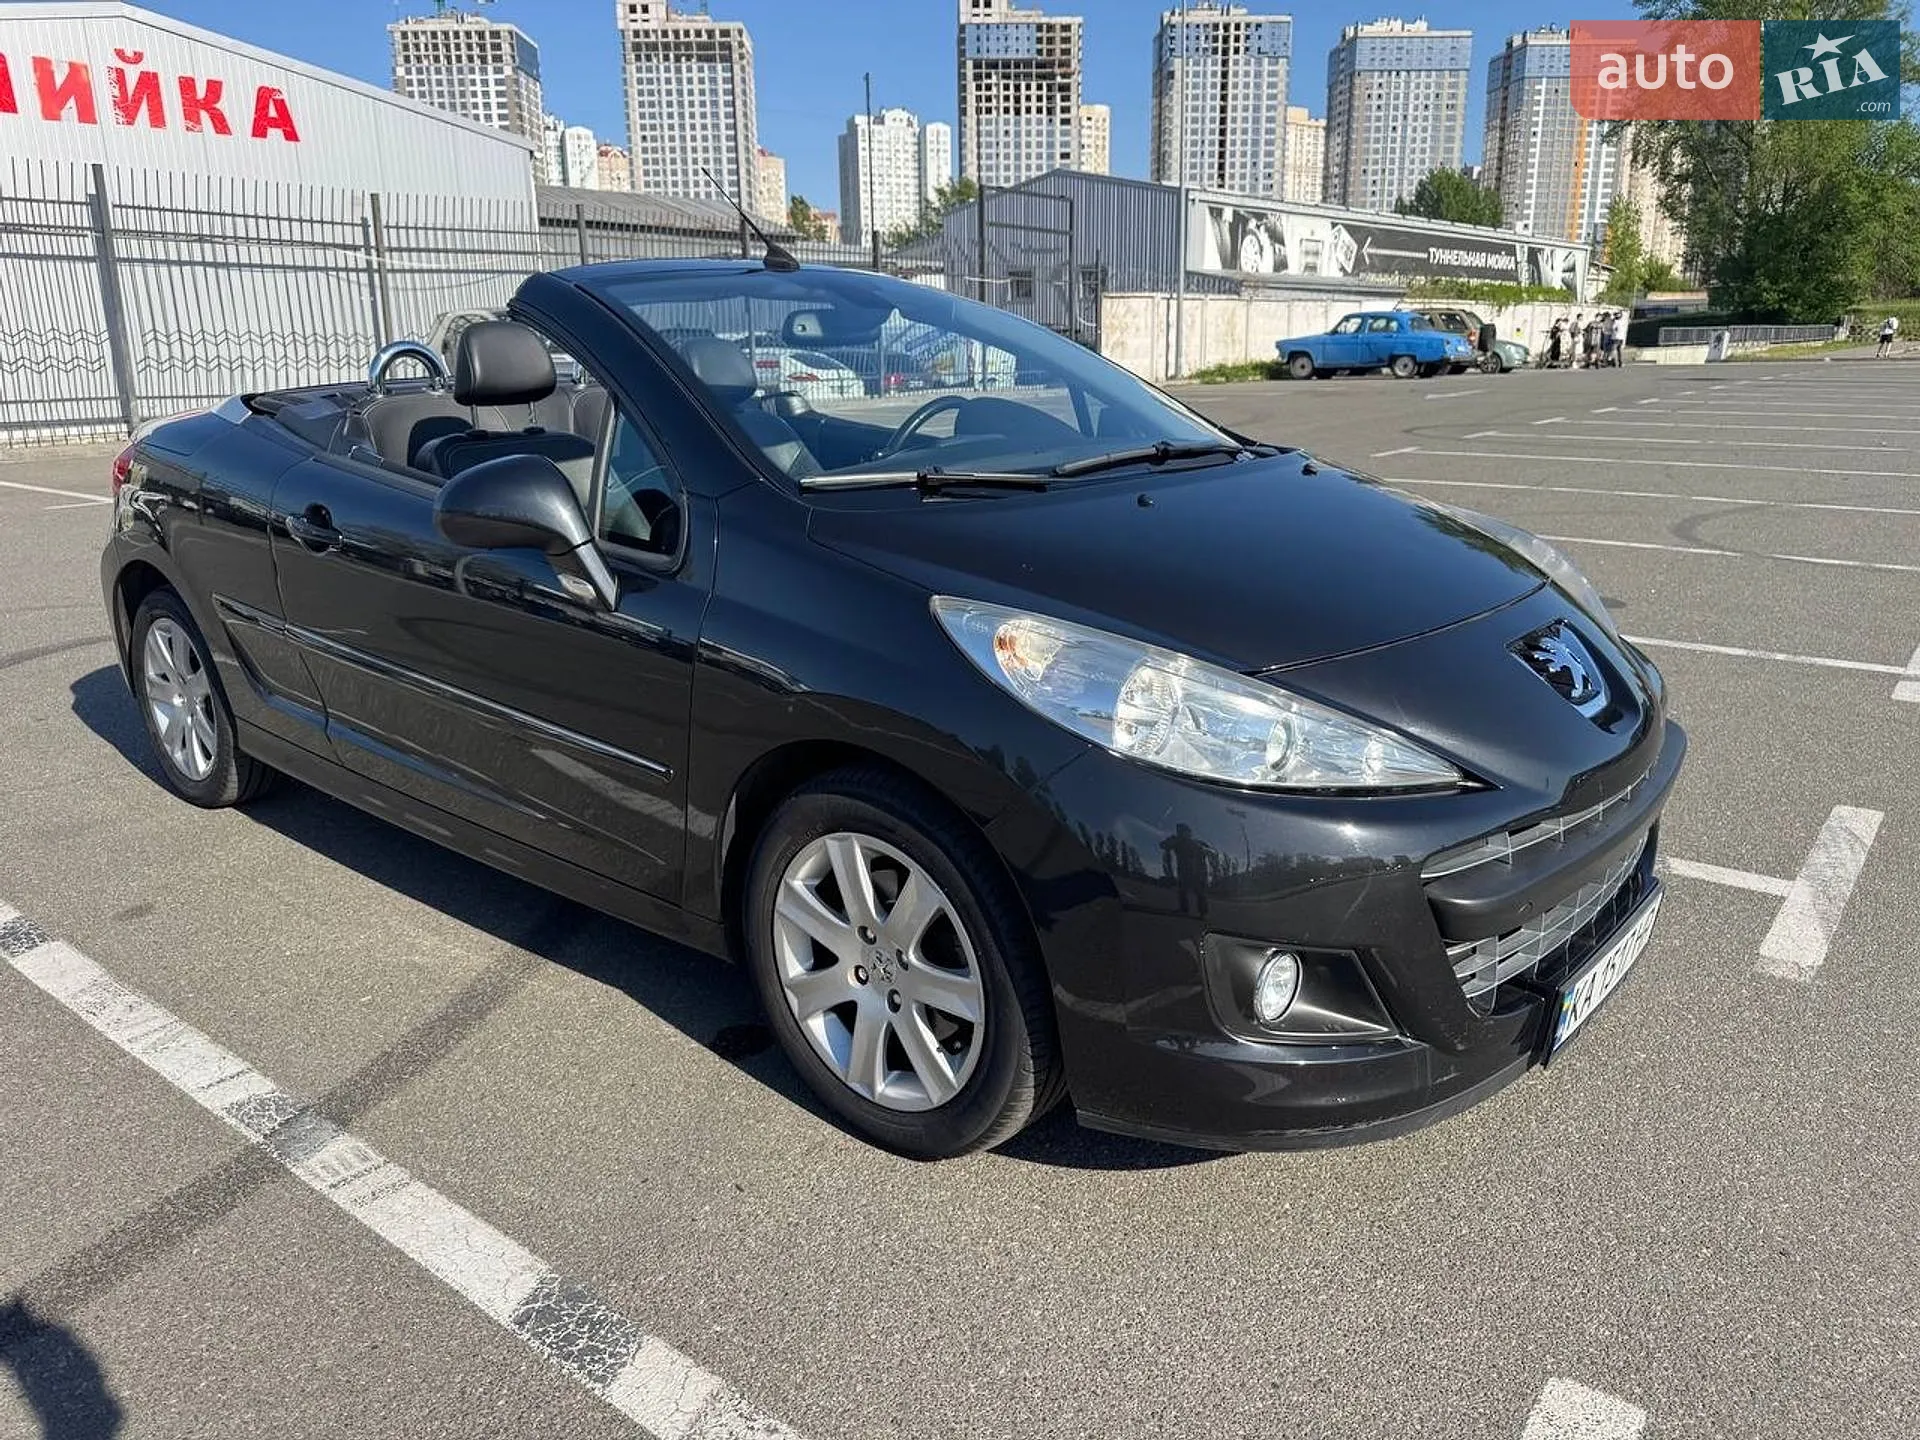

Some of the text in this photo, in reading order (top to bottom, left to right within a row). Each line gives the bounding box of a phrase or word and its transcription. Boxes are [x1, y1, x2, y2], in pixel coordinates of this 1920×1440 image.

[0, 47, 300, 142] ИЙКА
[1428, 246, 1516, 271] ТУННЕЛЬНАЯ МОЙКА
